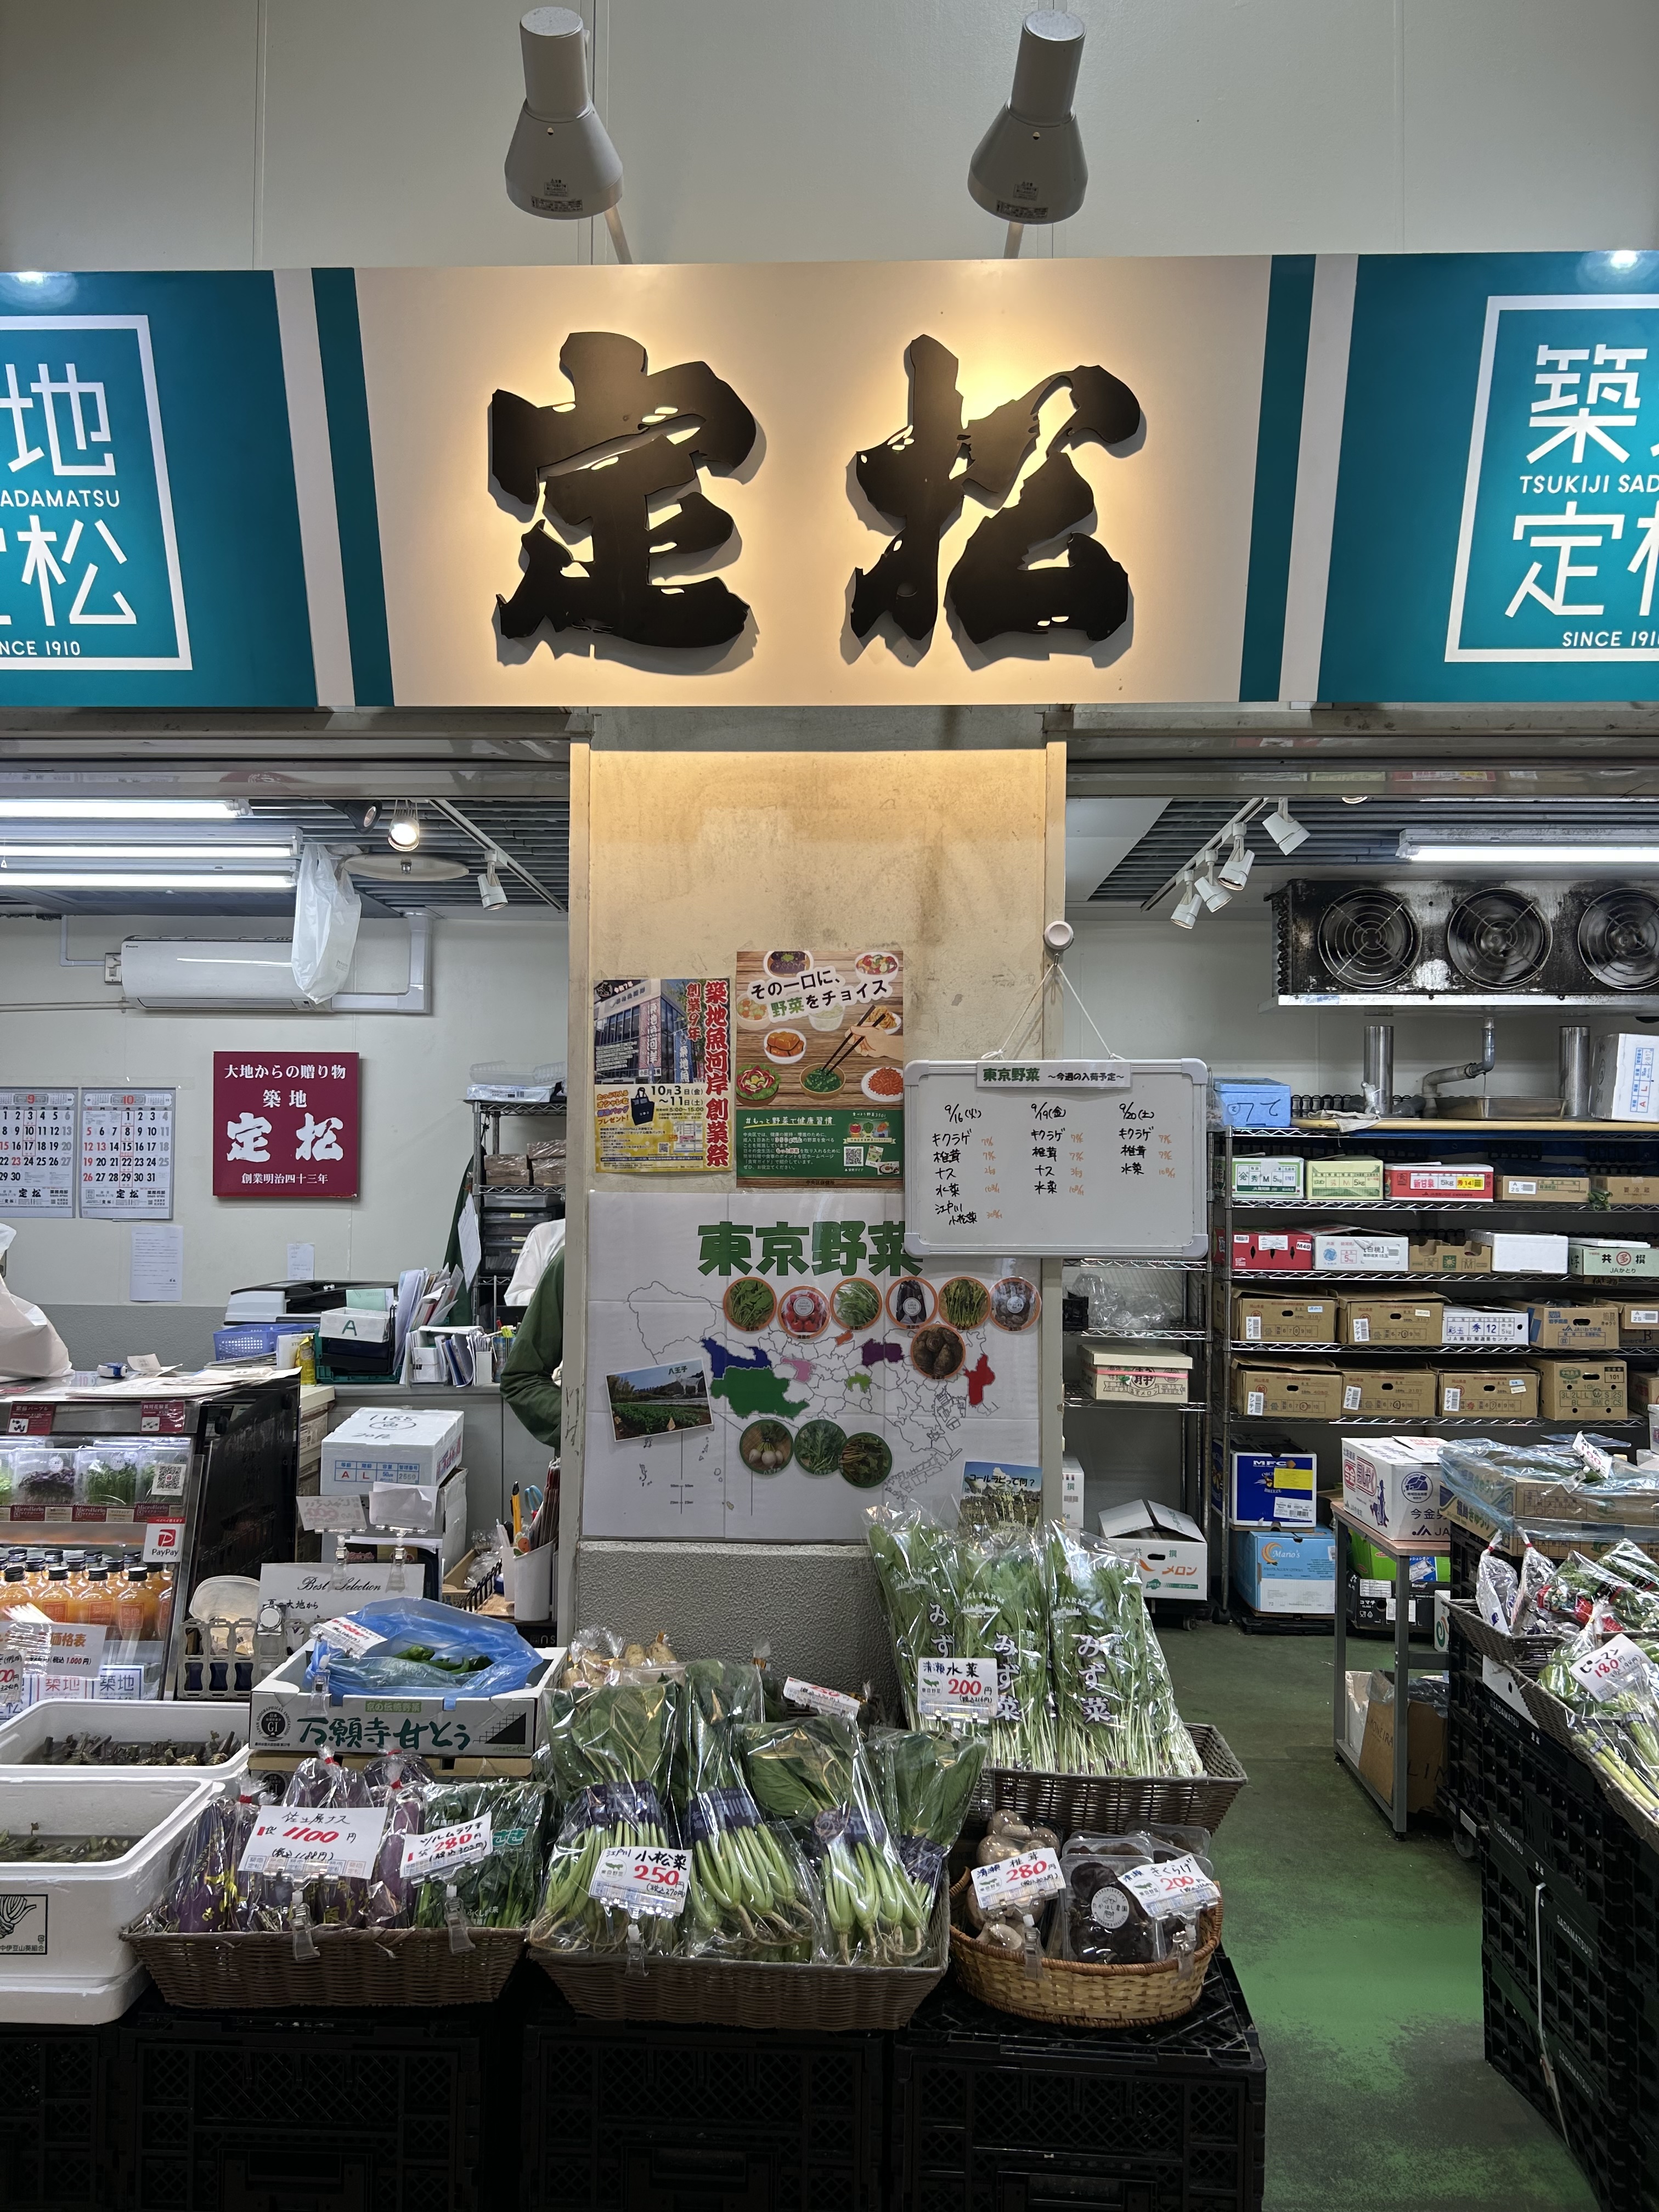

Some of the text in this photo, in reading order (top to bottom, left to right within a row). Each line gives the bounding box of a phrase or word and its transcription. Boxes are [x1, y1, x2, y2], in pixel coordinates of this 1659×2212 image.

[1526, 344, 1659, 464] 築
[492, 331, 1141, 648] 定松
[1520, 476, 1609, 493] TSUKIJI
[1562, 631, 1621, 647] SINCE
[46, 641, 81, 656] 1910
[751, 970, 840, 1000] その一口に、
[770, 980, 888, 1018] 野菜をチョイス
[224, 1064, 346, 1079] 大地からの贈り物
[983, 1068, 1040, 1082] 東京野菜
[27, 1094, 35, 1104] 9
[123, 1096, 134, 1104] 10
[263, 1090, 307, 1108] 築地
[127, 1112, 168, 1120] 1 2 3 4
[87, 1127, 169, 1136] 5 6 7 8 9 10 11
[227, 1112, 343, 1163] 定松
[932, 1128, 972, 1146] キクラゲ
[1031, 1127, 1065, 1141] キクラゲ
[1119, 1126, 1154, 1141] キクラゲ
[84, 1142, 169, 1151] 12 13 14 15 16 17 18
[83, 1158, 169, 1166] 19 20 21 22 23 24 25
[933, 1148, 961, 1163] 椎茸
[935, 1167, 956, 1180] ナス
[1035, 1165, 1054, 1176] ナス
[1121, 1162, 1144, 1175] 水菜
[83, 1173, 155, 1182] 26 27 28 29 30 31
[241, 1173, 328, 1184] 創業明治四十三年
[1273, 1175, 1282, 1183] 5kg
[935, 1183, 960, 1197] 水菜
[1034, 1181, 1057, 1194] 水菜
[935, 1200, 962, 1214] 江戸川
[949, 1211, 978, 1225] 小松菜
[697, 1221, 923, 1277] 東京野菜
[342, 1320, 358, 1336] A
[1486, 1324, 1497, 1334] 12
[668, 1365, 688, 1374] 八王子
[152, 1548, 179, 1557] PayPay
[1272, 1549, 1300, 1559] Mario's
[1162, 1566, 1197, 1576] メロン
[297, 1577, 381, 1591] Best Selection
[946, 1662, 979, 1678] 水菜
[993, 1632, 1022, 1721] みず菜
[46, 1677, 80, 1692] 築地
[100, 1675, 134, 1692] 築地
[1078, 1635, 1110, 1723] みず菜
[366, 1701, 421, 1713] 京の伝統野菜
[1492, 1702, 1520, 1729] SADAMATSU
[267, 1722, 278, 1733] GI
[297, 1717, 471, 1751] 万願寺甘とう
[283, 1827, 339, 1843] 1100
[1496, 1822, 1523, 1855] SADAMATSU
[635, 1850, 687, 1871] 小松菜
[1150, 1858, 1192, 1877] きくらげ
[1557, 1914, 1589, 1955] SADAMATSU
